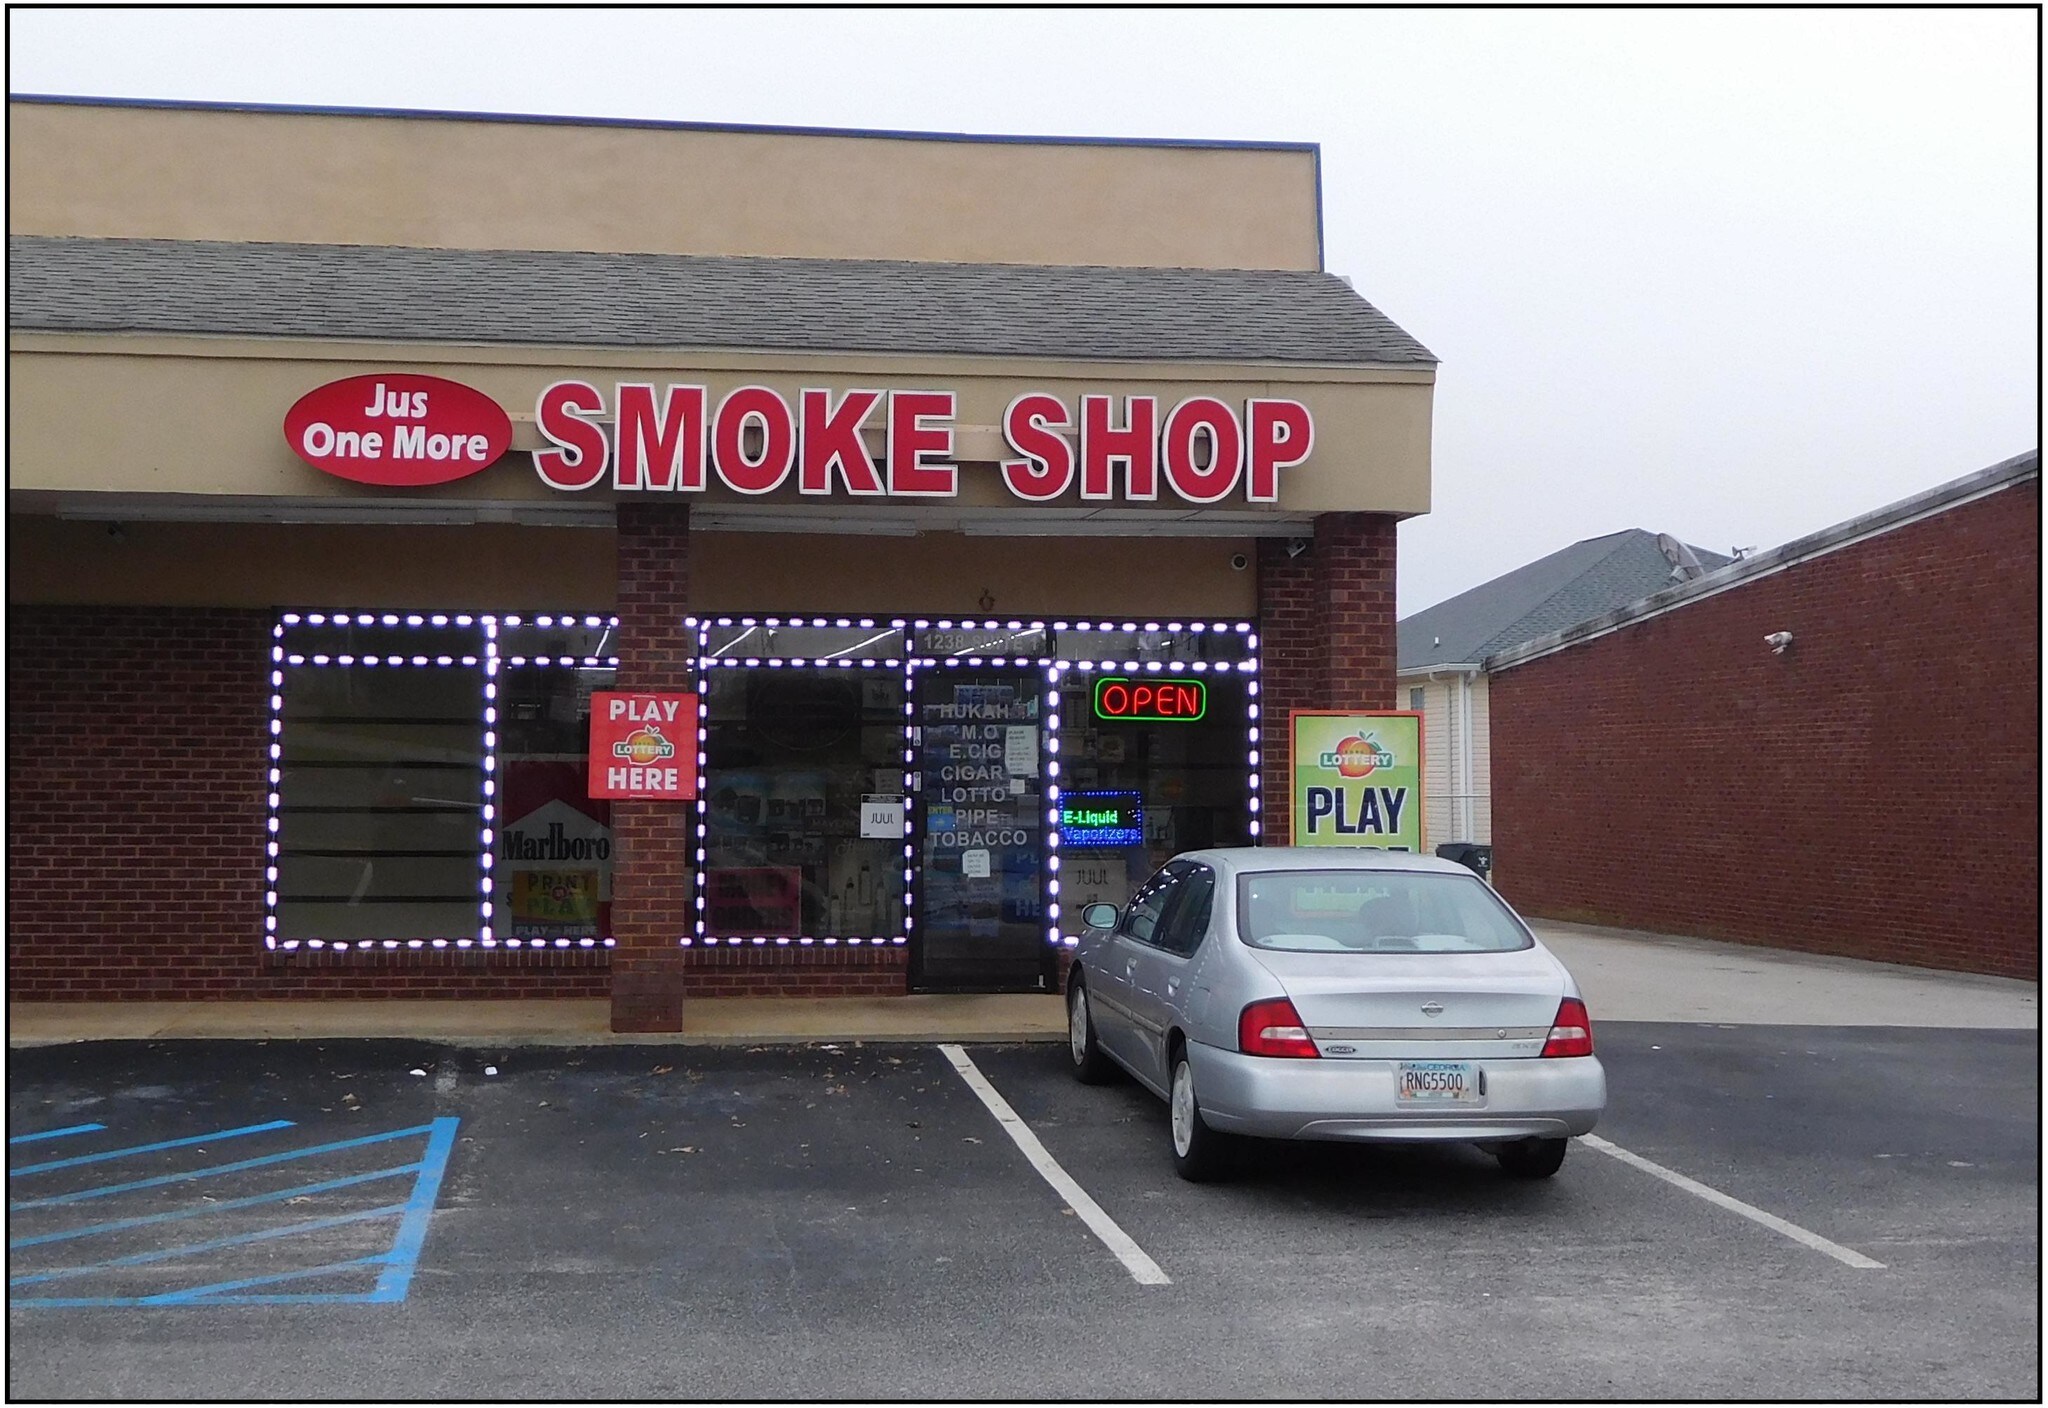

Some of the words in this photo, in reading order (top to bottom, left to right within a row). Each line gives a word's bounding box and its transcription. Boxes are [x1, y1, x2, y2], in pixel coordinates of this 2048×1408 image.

[365, 382, 428, 419] Jus
[302, 423, 382, 460] One
[393, 426, 489, 462] More
[532, 379, 957, 498] SMOKE
[1001, 392, 1316, 503] SHOP
[924, 632, 964, 650] 1238
[1103, 685, 1198, 716] OPEN
[608, 699, 680, 722] PLAY
[940, 703, 1009, 719] HUKAH
[616, 744, 672, 755] LOTTERY
[949, 743, 1002, 759] E.CIG
[1323, 753, 1390, 766] LOTTERY
[608, 767, 679, 791] HERE
[940, 765, 1003, 781] CIGAR
[941, 787, 1006, 803] LOTTO
[870, 812, 895, 825] JUUL
[955, 809, 998, 825] PIPE
[1063, 809, 1118, 826] E-Liquid
[1306, 786, 1407, 835] PLAY
[501, 822, 610, 861] Marlboro
[930, 830, 1028, 847] TOBACCO
[1063, 826, 1138, 841] Vaporizers
[1075, 869, 1109, 885] JUUL
[1406, 1072, 1463, 1091] RNG5500
